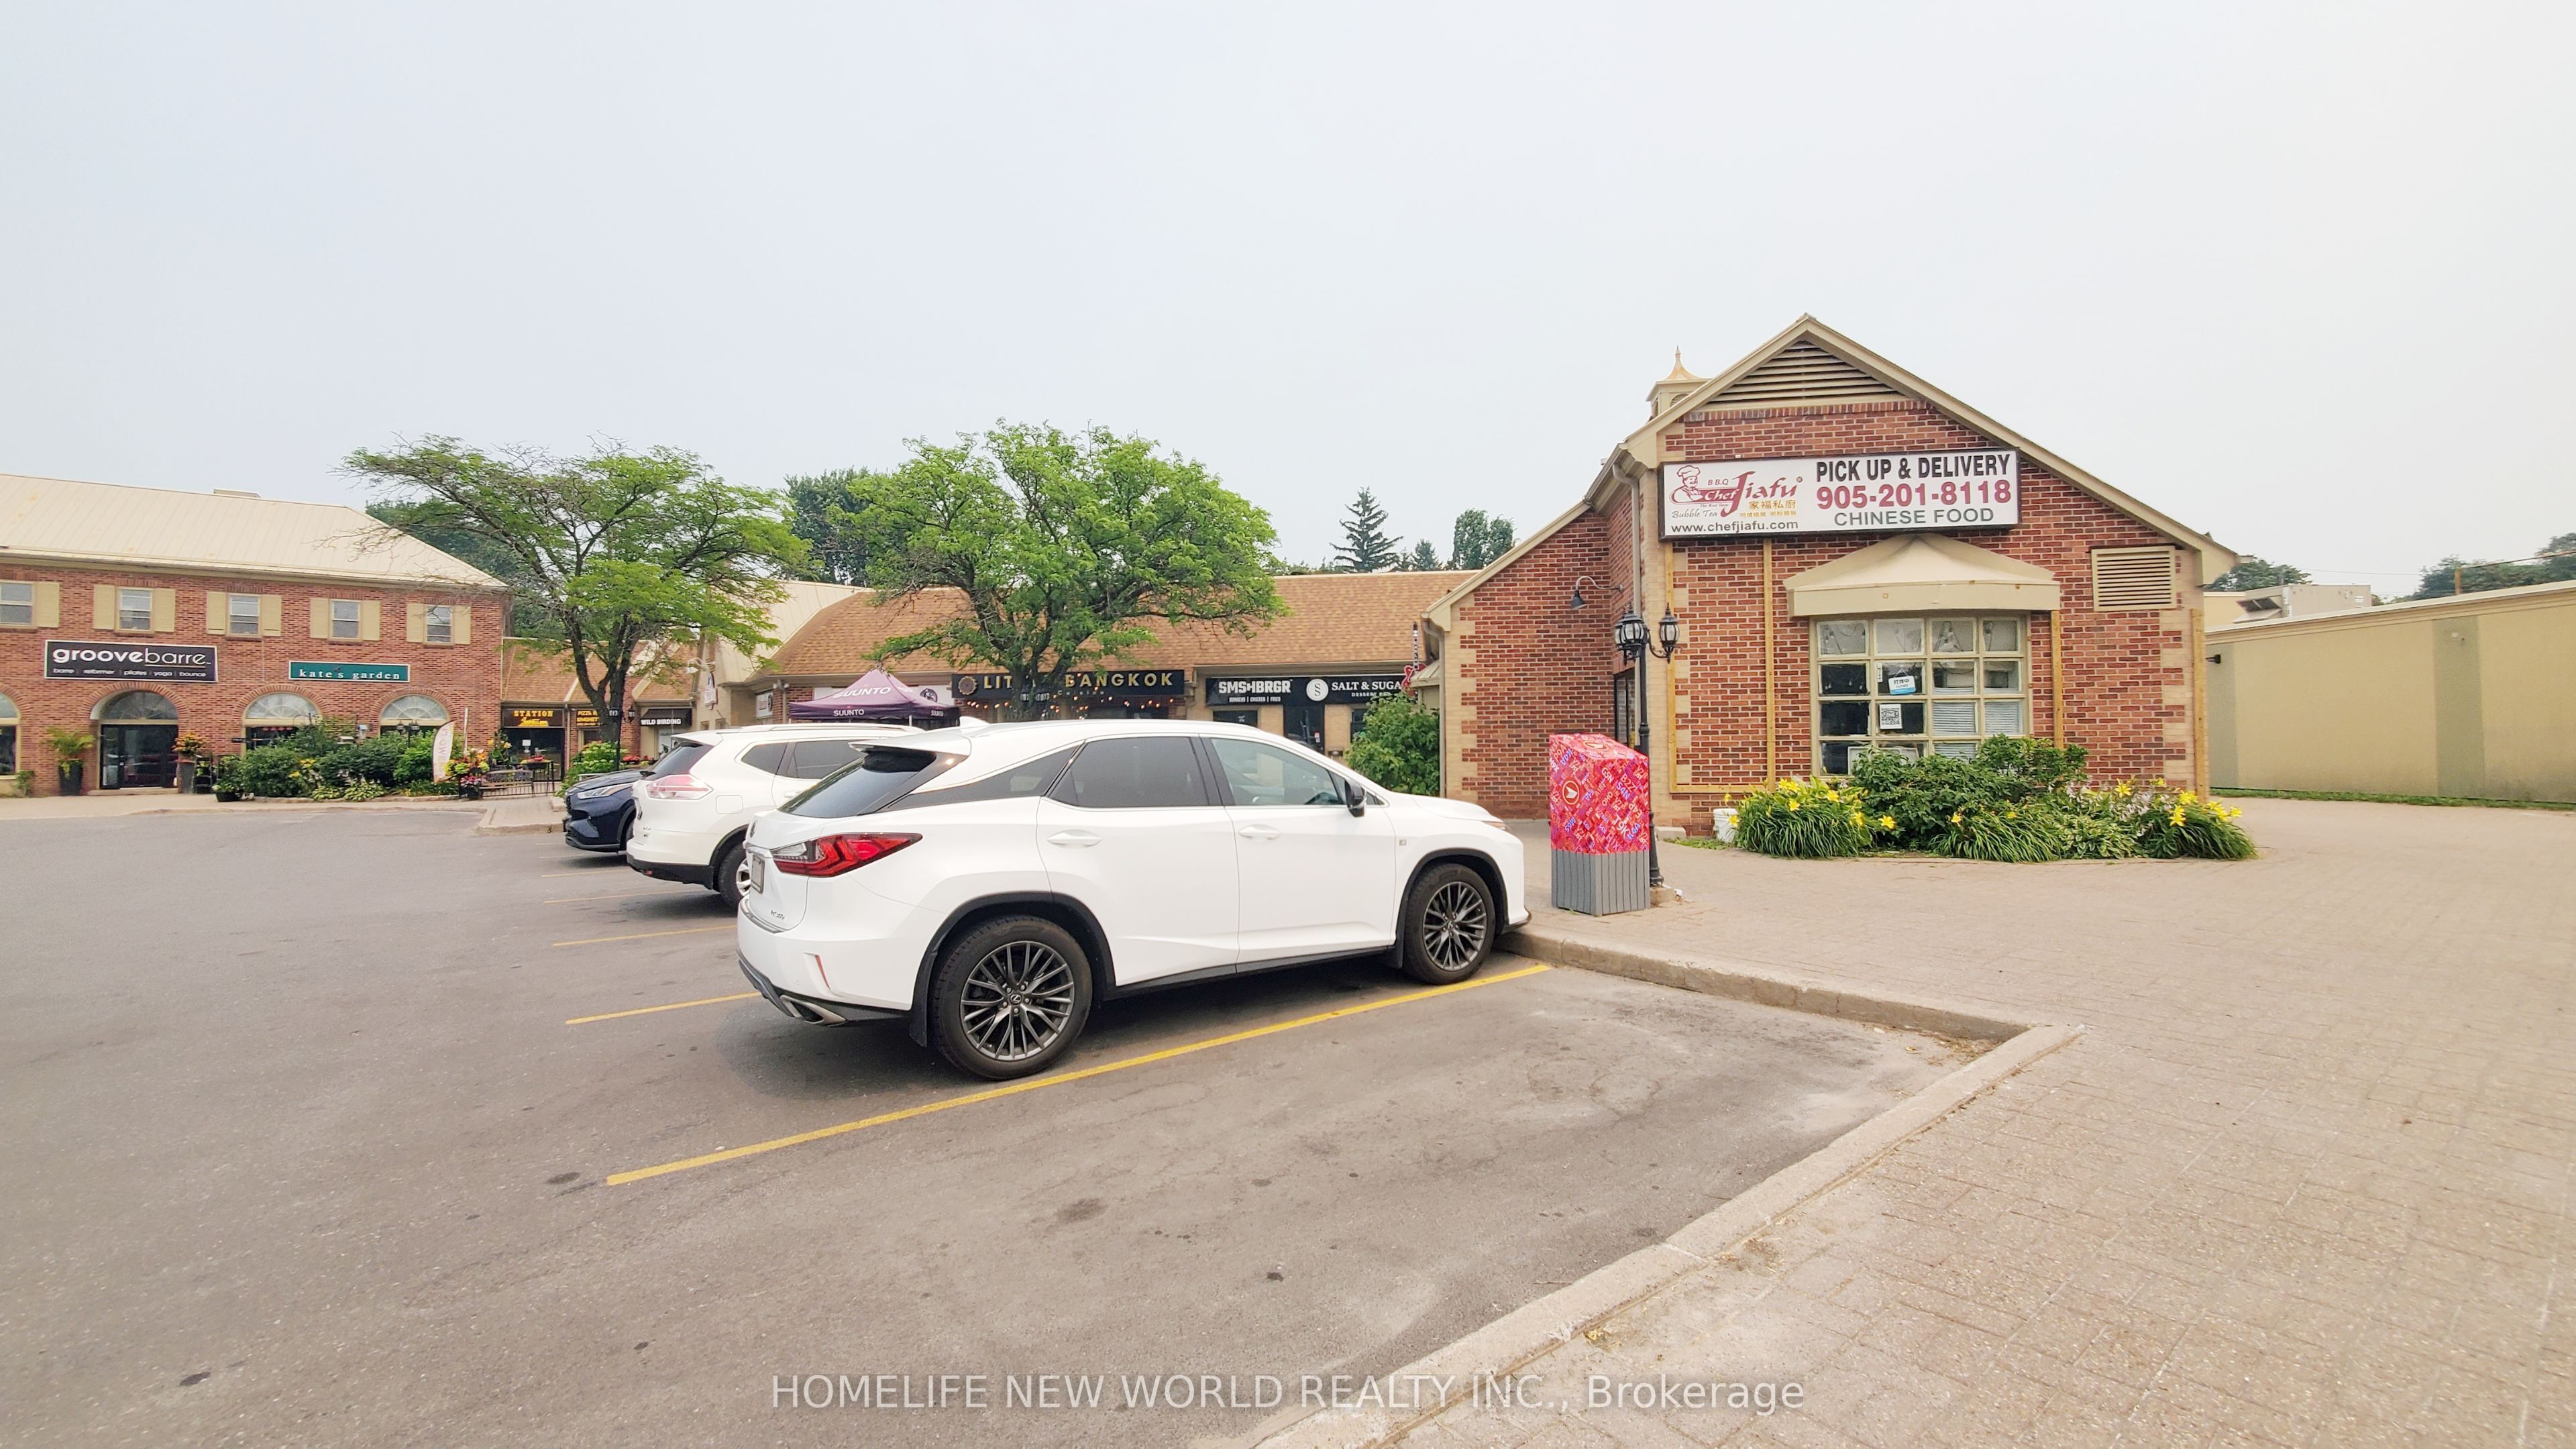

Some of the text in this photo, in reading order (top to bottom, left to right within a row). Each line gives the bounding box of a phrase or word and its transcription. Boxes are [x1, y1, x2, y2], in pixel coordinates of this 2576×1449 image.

[1817, 454, 2010, 482] PICK UP & DELIVERY
[1705, 488, 1740, 501] Chef
[1720, 471, 1798, 518] Jiafu
[1817, 479, 2011, 509] 905-201-8118
[1672, 508, 1717, 519] Bubble Tea
[1834, 508, 1994, 526] CHINESE FOOD
[1671, 520, 1798, 533] www.chefjiafu.com
[352, 672, 400, 680] garden
[1065, 672, 1173, 688] BANGKOK
[833, 686, 892, 698] SUUNTO
[1332, 680, 1401, 691] SALT & SUGA
[1621, 773, 1636, 793] B2Z
